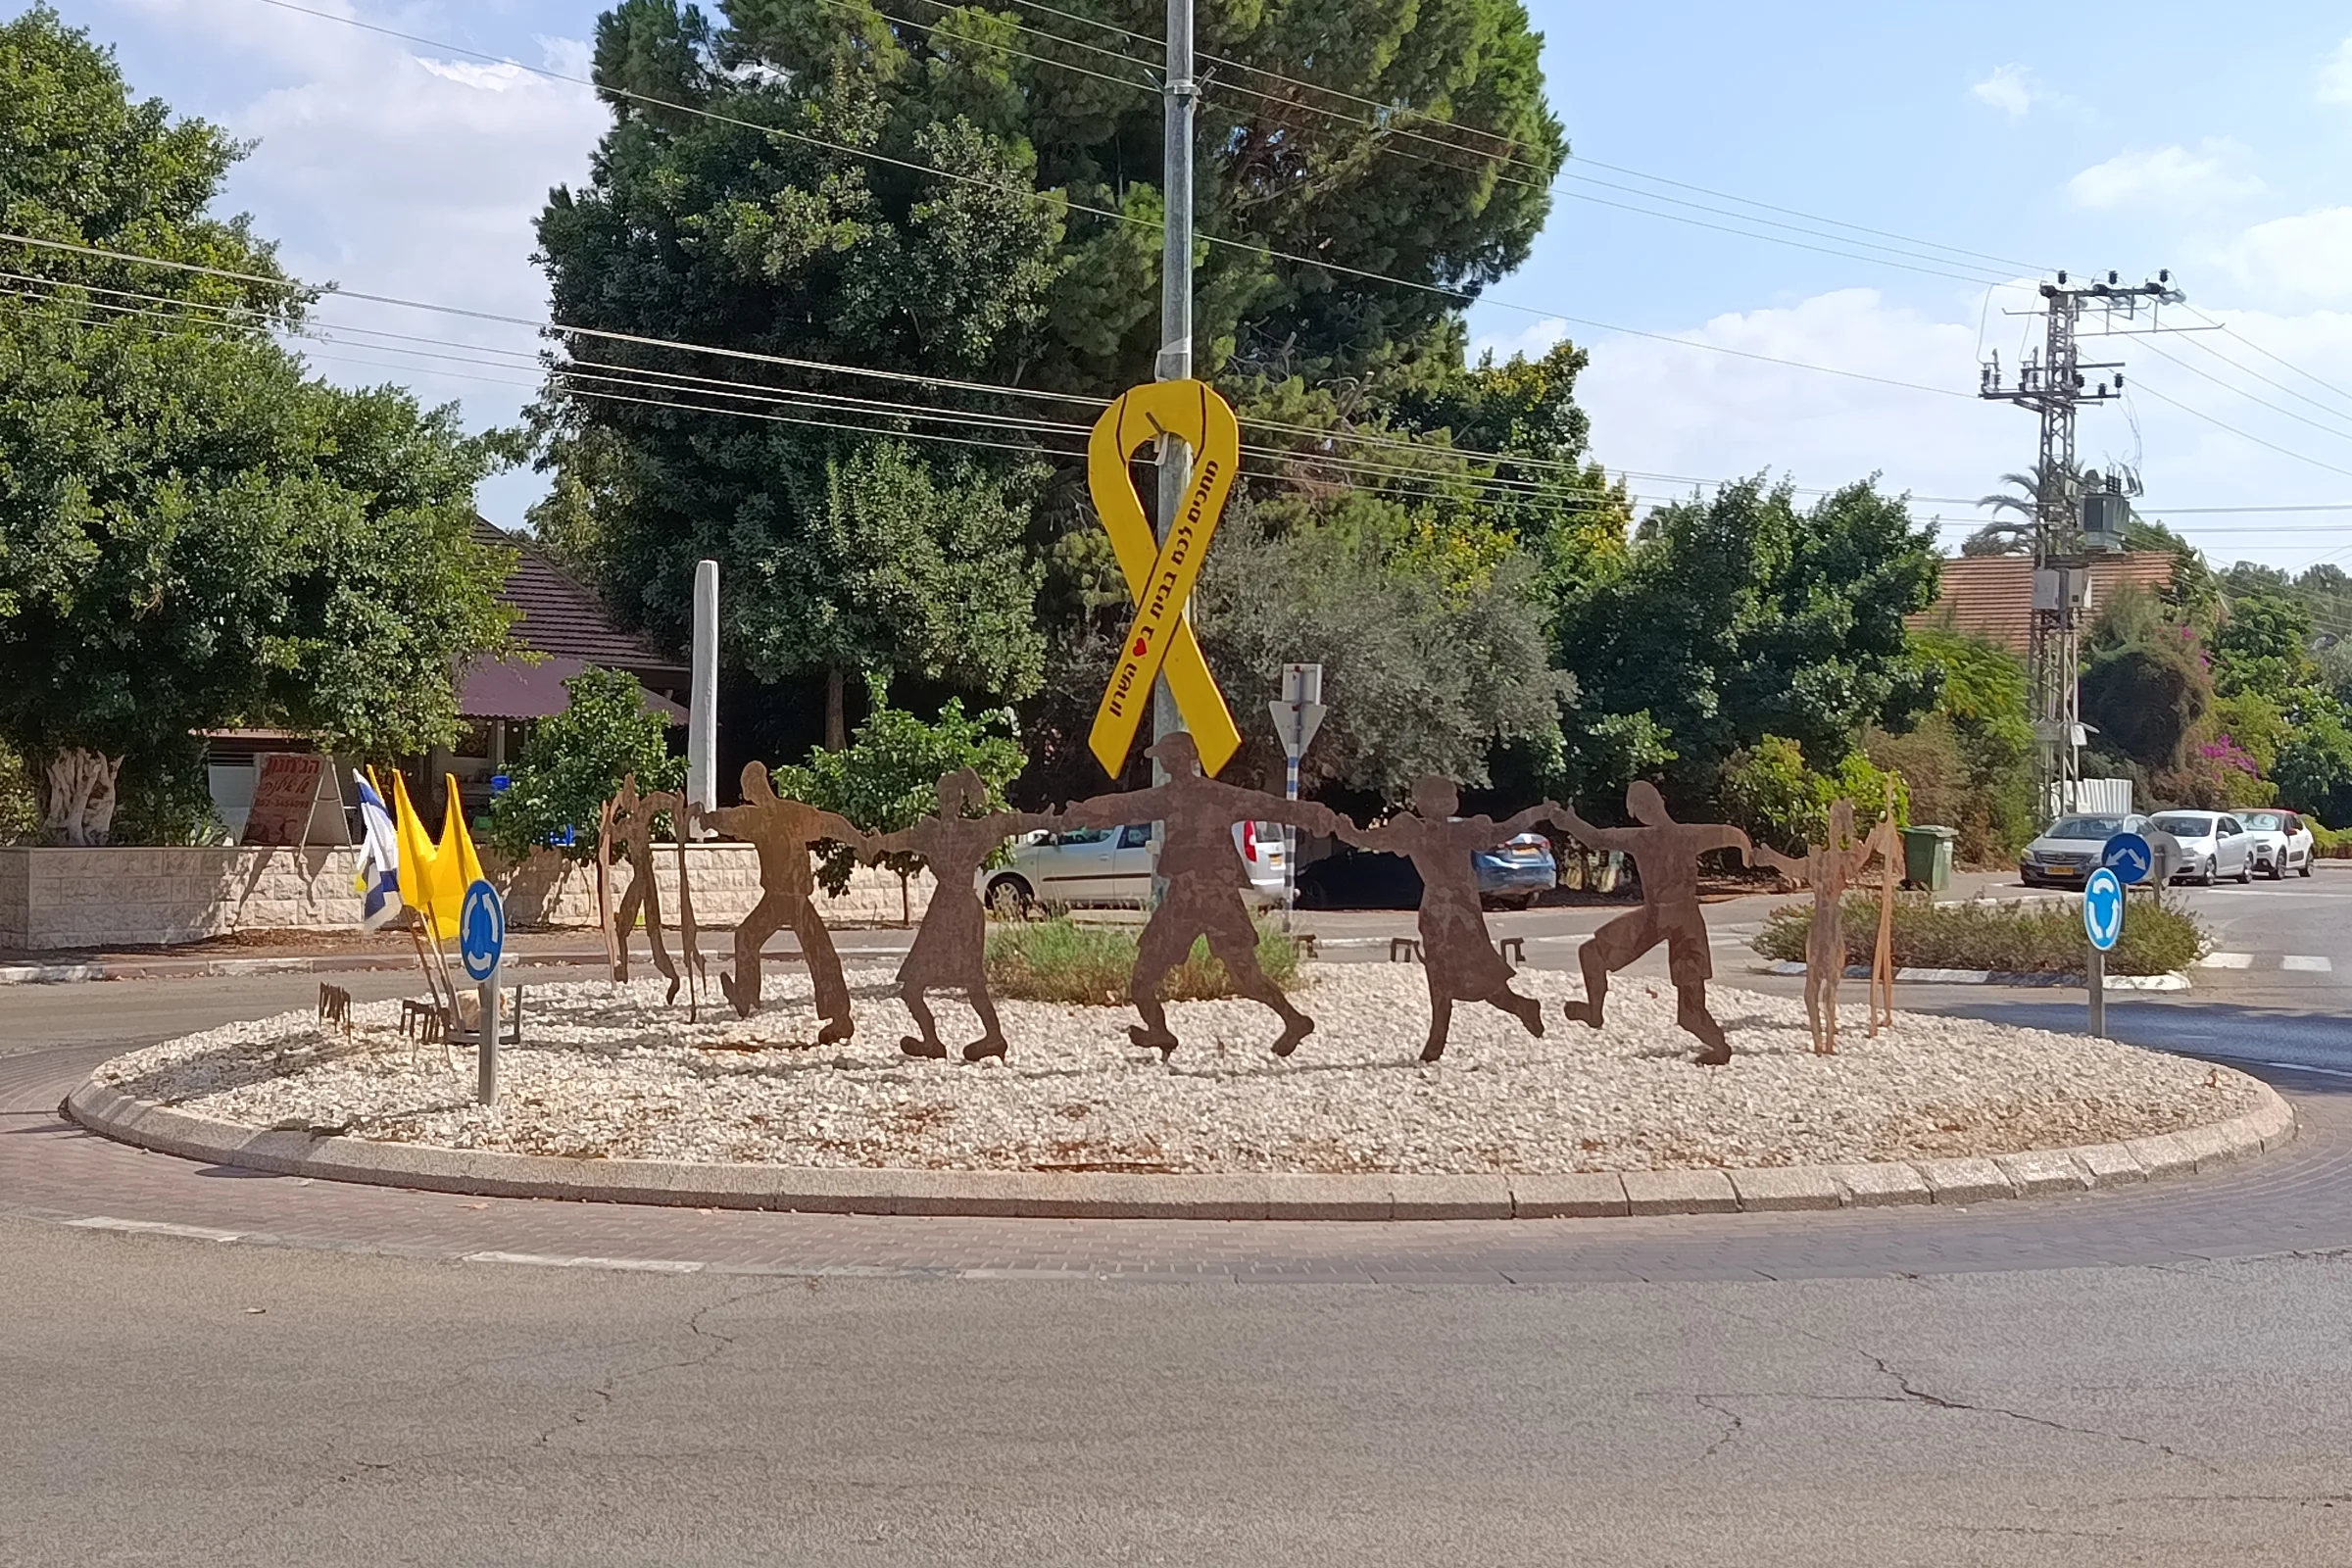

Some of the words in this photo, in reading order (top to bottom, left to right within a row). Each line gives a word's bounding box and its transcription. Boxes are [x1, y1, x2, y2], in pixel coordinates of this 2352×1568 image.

[1187, 460, 1218, 524] מחכים
[1171, 525, 1193, 565] לכם
[1150, 571, 1177, 620] בבית
[1108, 662, 1137, 718] השרון
